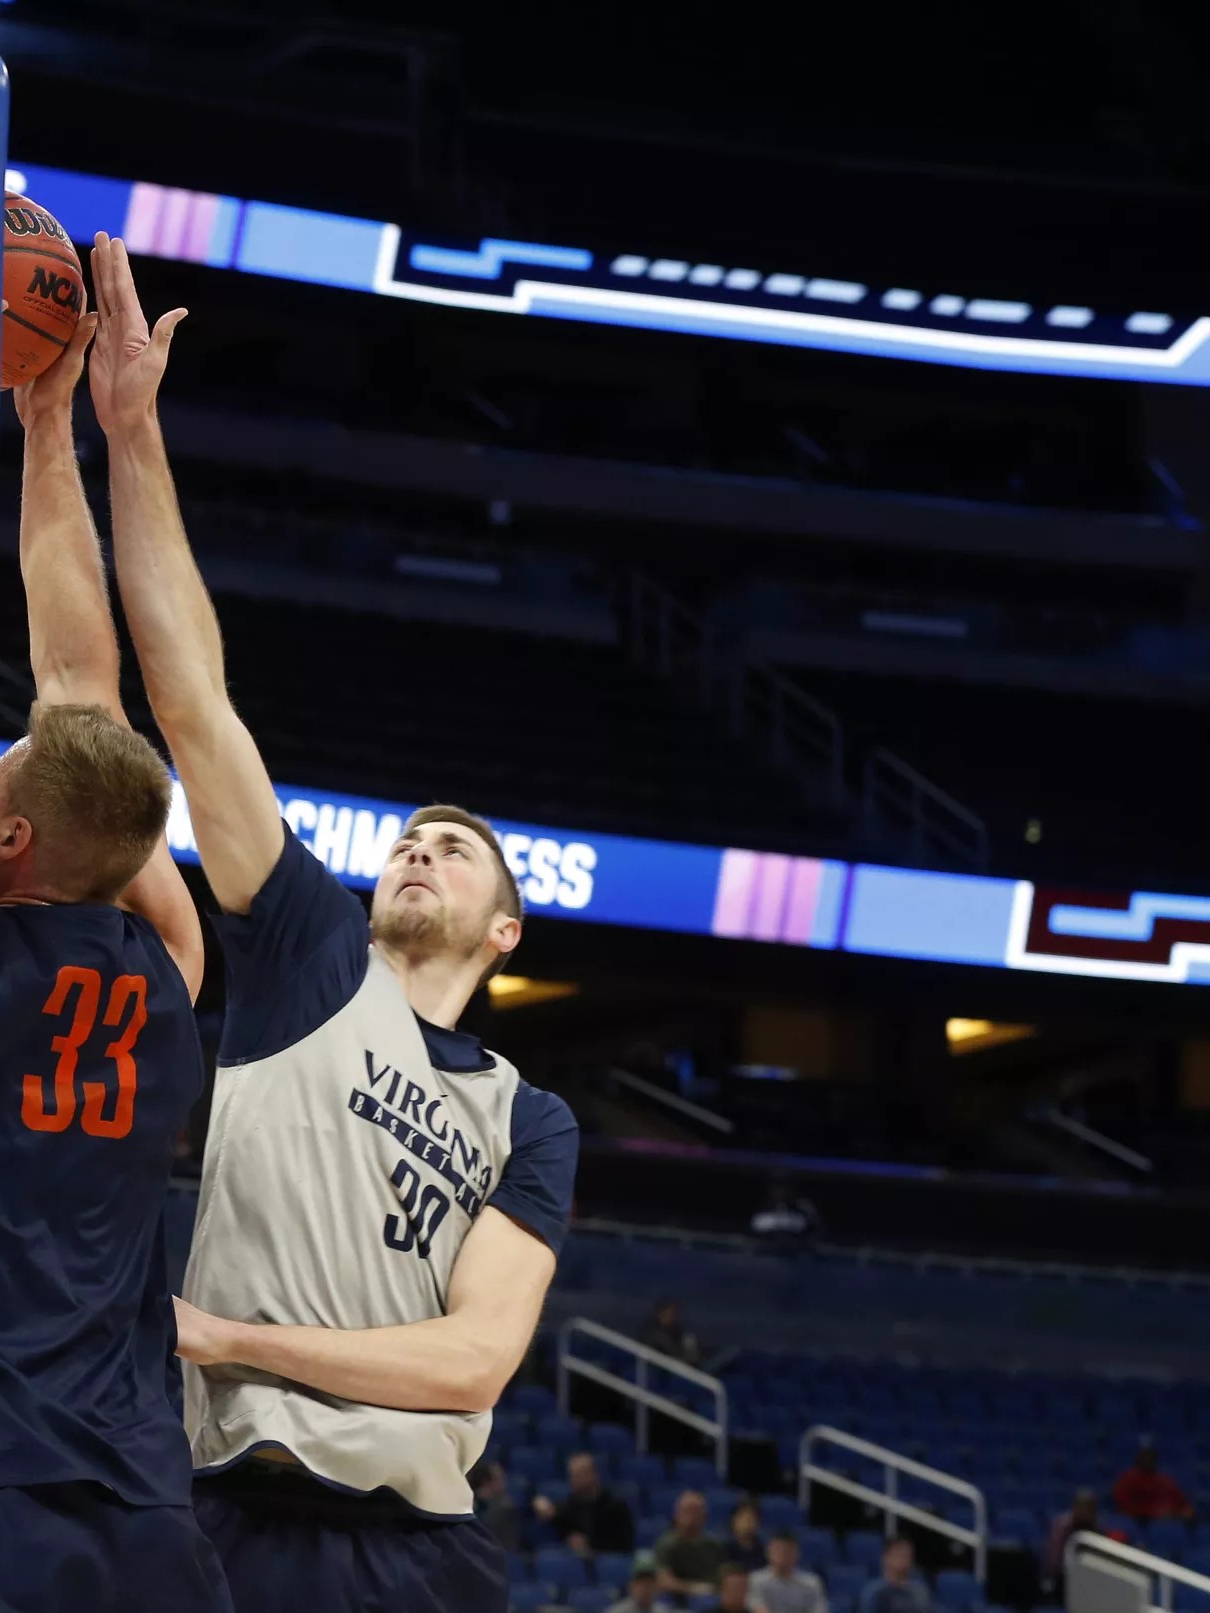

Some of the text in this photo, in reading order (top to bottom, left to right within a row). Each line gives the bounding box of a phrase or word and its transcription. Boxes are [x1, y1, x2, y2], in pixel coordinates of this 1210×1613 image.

[26, 265, 82, 314] NCA
[21, 965, 148, 1139] 33
[364, 1049, 492, 1198] VIRGNA
[384, 1159, 451, 1259] 30
